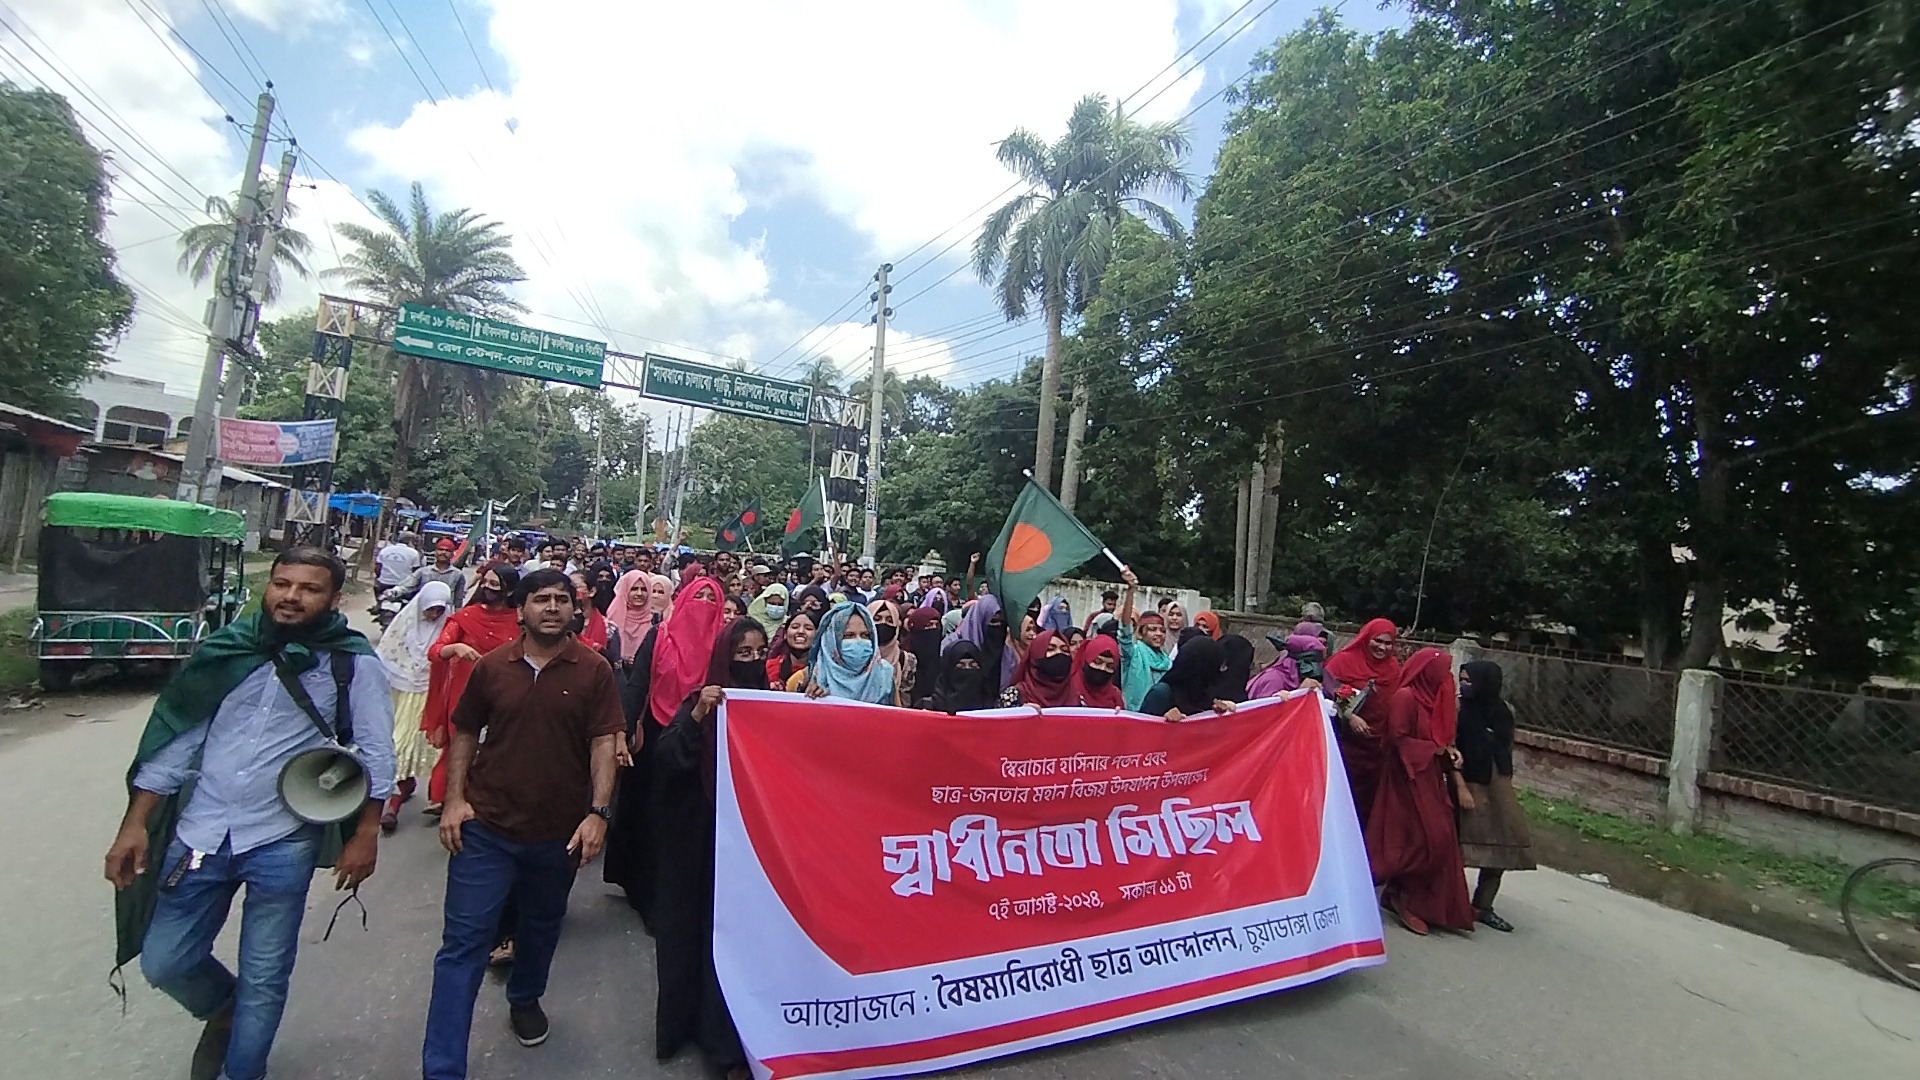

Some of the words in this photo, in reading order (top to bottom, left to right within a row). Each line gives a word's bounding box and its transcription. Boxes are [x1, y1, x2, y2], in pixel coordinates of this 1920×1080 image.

[437, 342, 462, 354] রেল
[567, 366, 595, 377] সড়ক
[1001, 756, 1056, 778] স্বৈরাচার
[1060, 753, 1109, 774] হাসিনার
[1112, 753, 1141, 770] পতন
[1143, 751, 1167, 767] এবং
[931, 785, 1030, 804] ছাত্র-জনতার
[1032, 782, 1068, 802] মহান
[1070, 778, 1109, 800] বিজয়
[1110, 772, 1158, 795] উদযাপন
[881, 814, 1102, 898] স্বাধীনতা
[1105, 798, 1262, 865] মিছিল
[988, 896, 1011, 920] ৭ই
[1119, 878, 1157, 901] সকাল
[1160, 874, 1176, 893] ১১
[1177, 872, 1192, 890] টা
[781, 990, 916, 1028] আয়োজনে
[932, 947, 1085, 1009] বৈষম্যবিরোধী
[1088, 947, 1132, 980] ছাত্র
[1136, 926, 1243, 966] আন্দোলন,
[1243, 913, 1311, 954] চুয়াডাঙ্গা
[1312, 905, 1341, 930] জেলা
